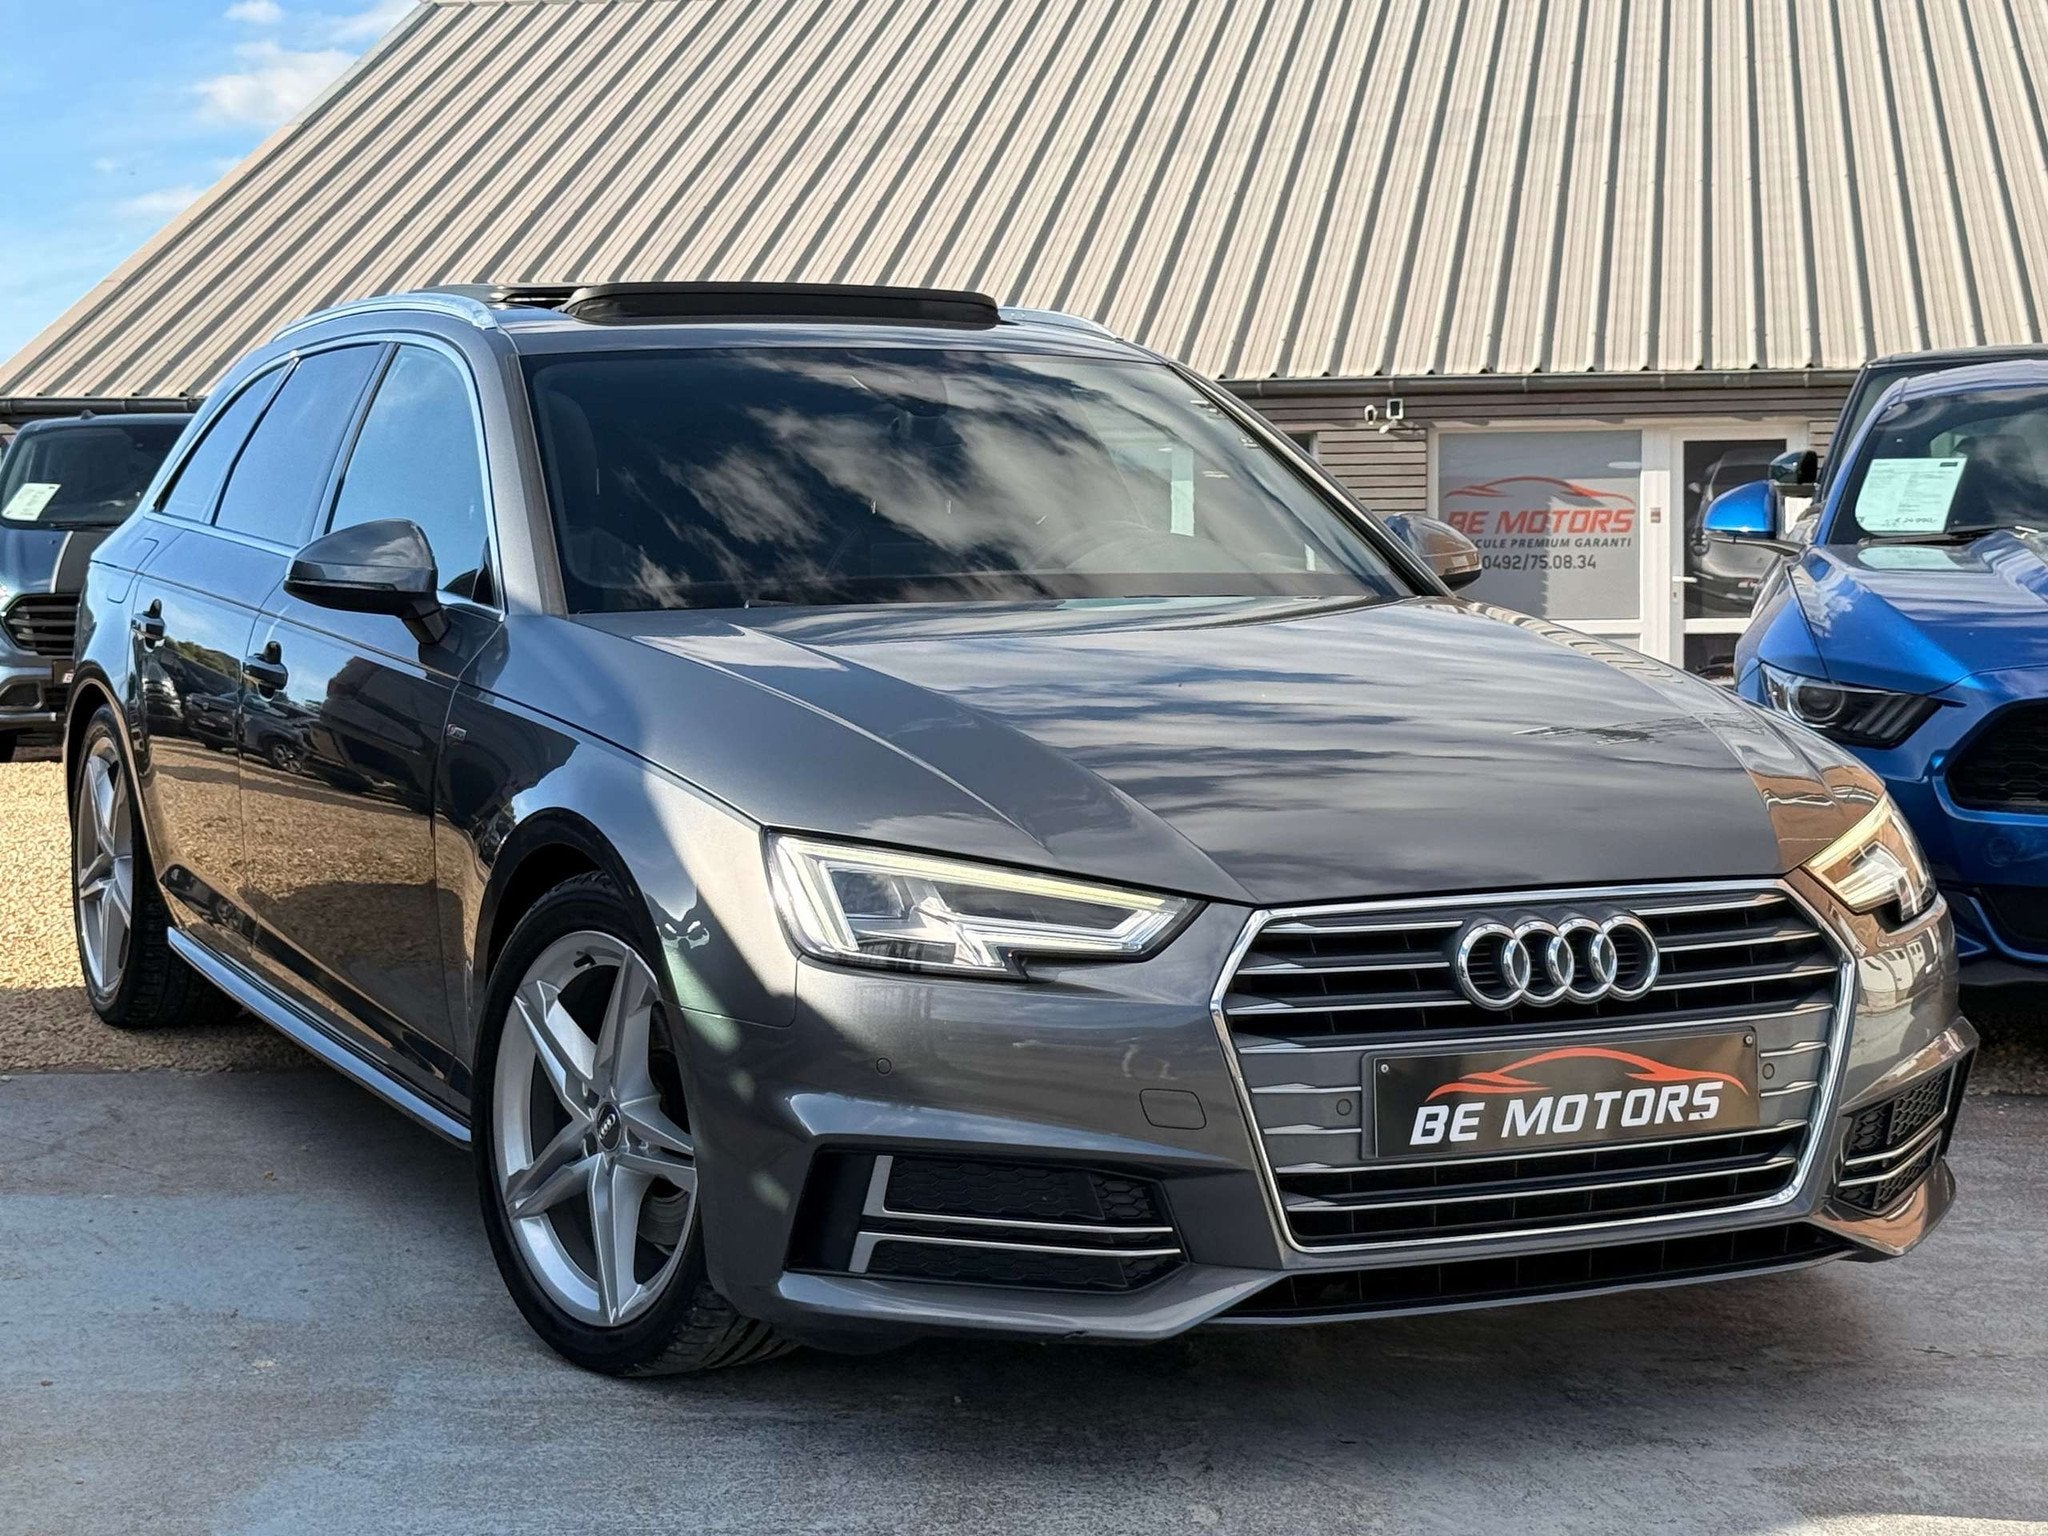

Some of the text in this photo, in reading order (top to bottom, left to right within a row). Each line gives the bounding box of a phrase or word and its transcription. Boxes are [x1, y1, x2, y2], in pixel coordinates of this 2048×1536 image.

[1495, 509, 1635, 534] MOTORS
[1471, 538, 1632, 549] CULE PREMIUM GARANTI
[1482, 554, 1597, 571] 0492/75.08.34
[1410, 1081, 1723, 1146] BE MOTORS
